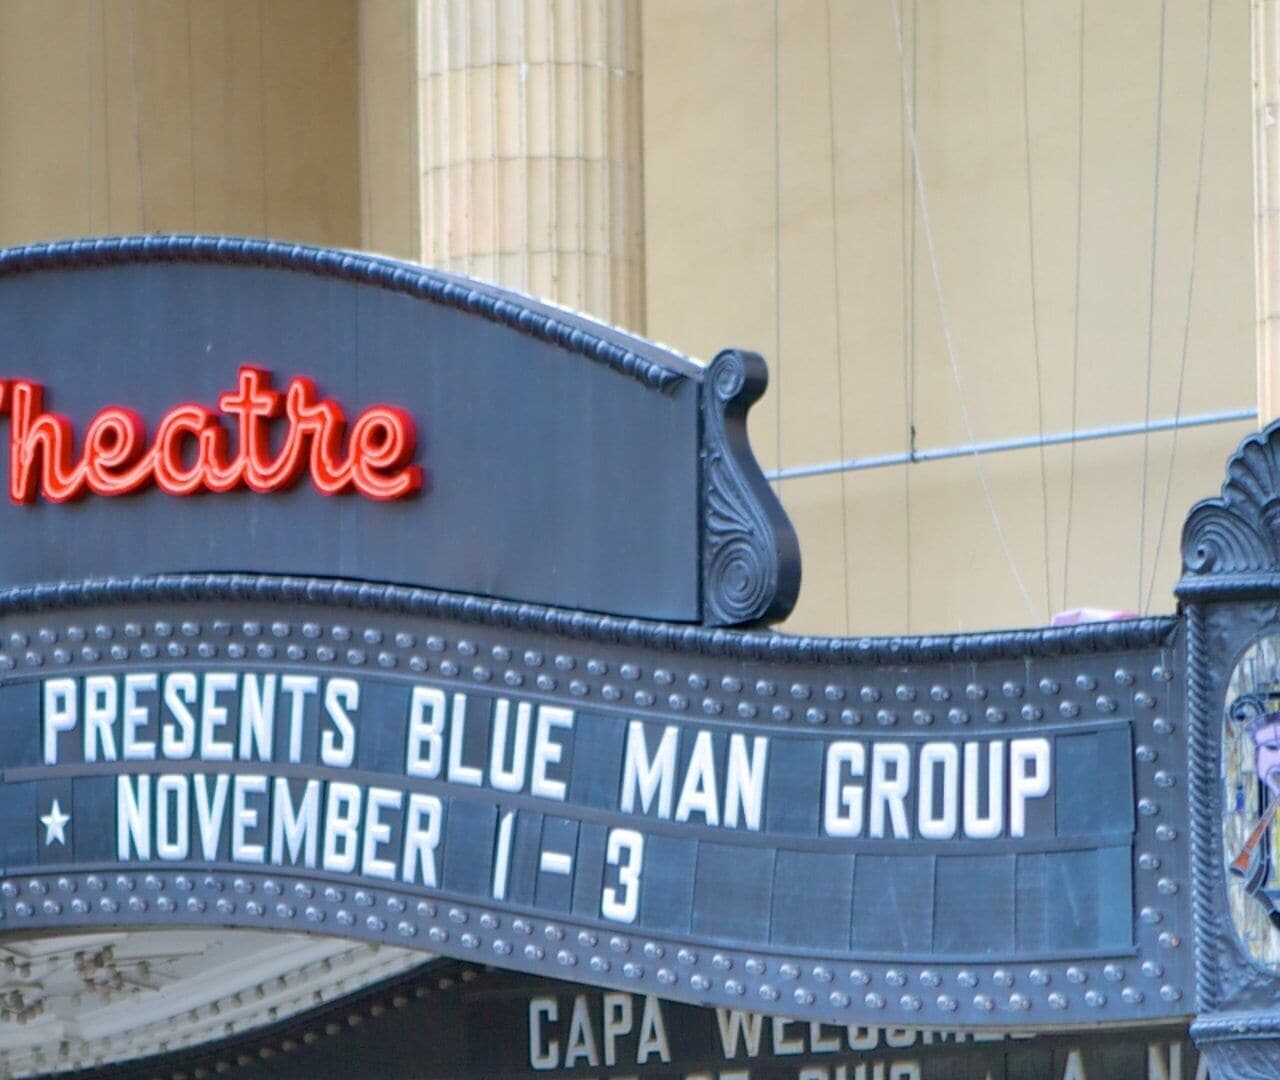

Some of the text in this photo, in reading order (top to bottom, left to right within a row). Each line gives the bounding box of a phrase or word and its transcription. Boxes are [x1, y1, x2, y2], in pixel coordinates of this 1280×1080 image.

[43, 672, 360, 768] PRESENTS
[407, 685, 577, 800] BLUE
[620, 719, 769, 832] MAN
[824, 737, 1052, 841] GROUP
[117, 773, 442, 888] NOVEMBER
[528, 995, 671, 1071] CAPA
